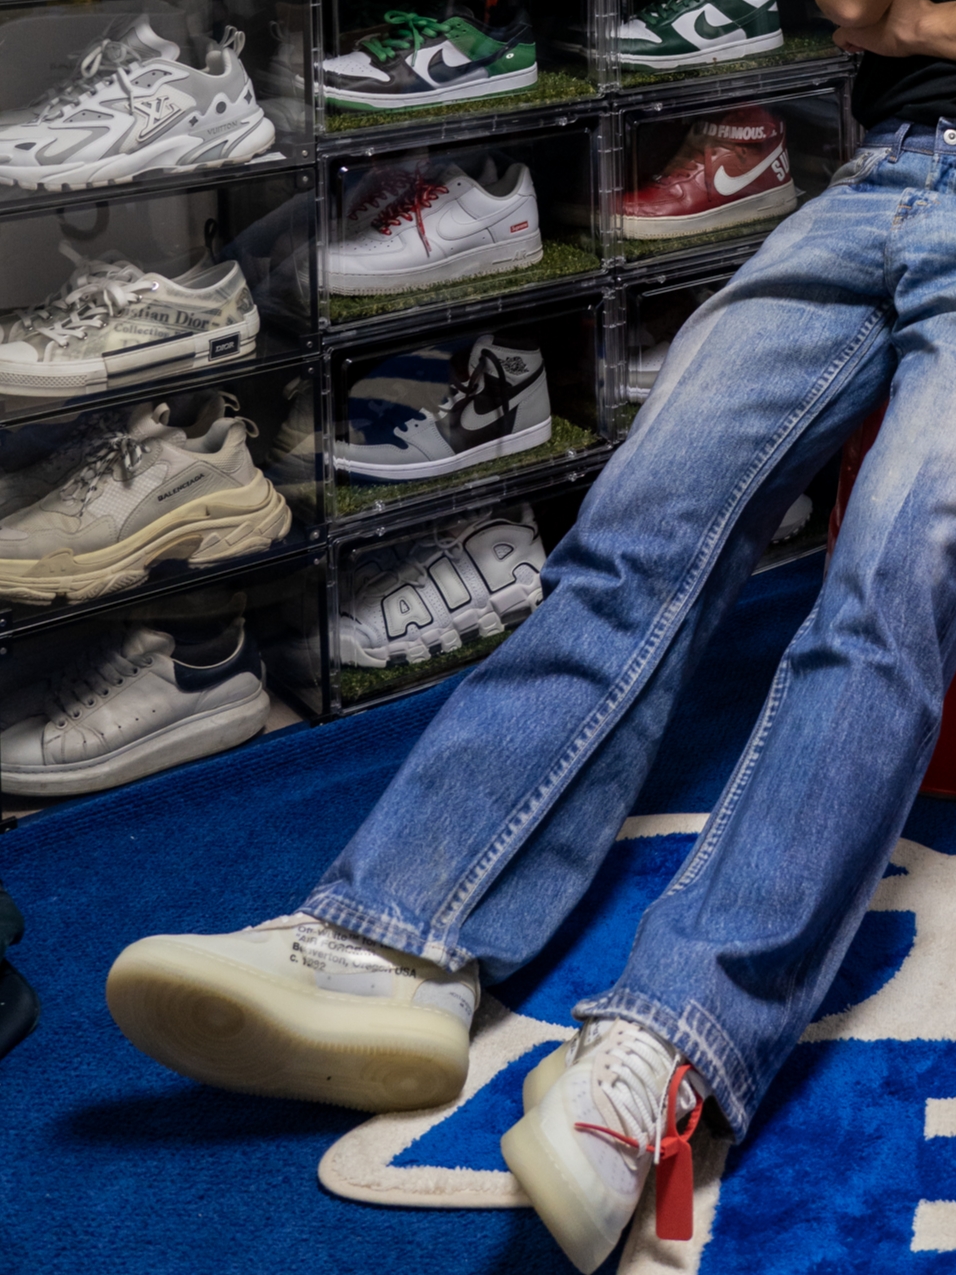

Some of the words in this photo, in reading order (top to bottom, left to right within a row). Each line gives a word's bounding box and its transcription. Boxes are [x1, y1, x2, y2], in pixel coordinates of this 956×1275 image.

[207, 120, 238, 136] VUITTON
[215, 341, 235, 353] DIOR
[157, 473, 205, 502] BALENCIAGA
[395, 966, 417, 979] USA
